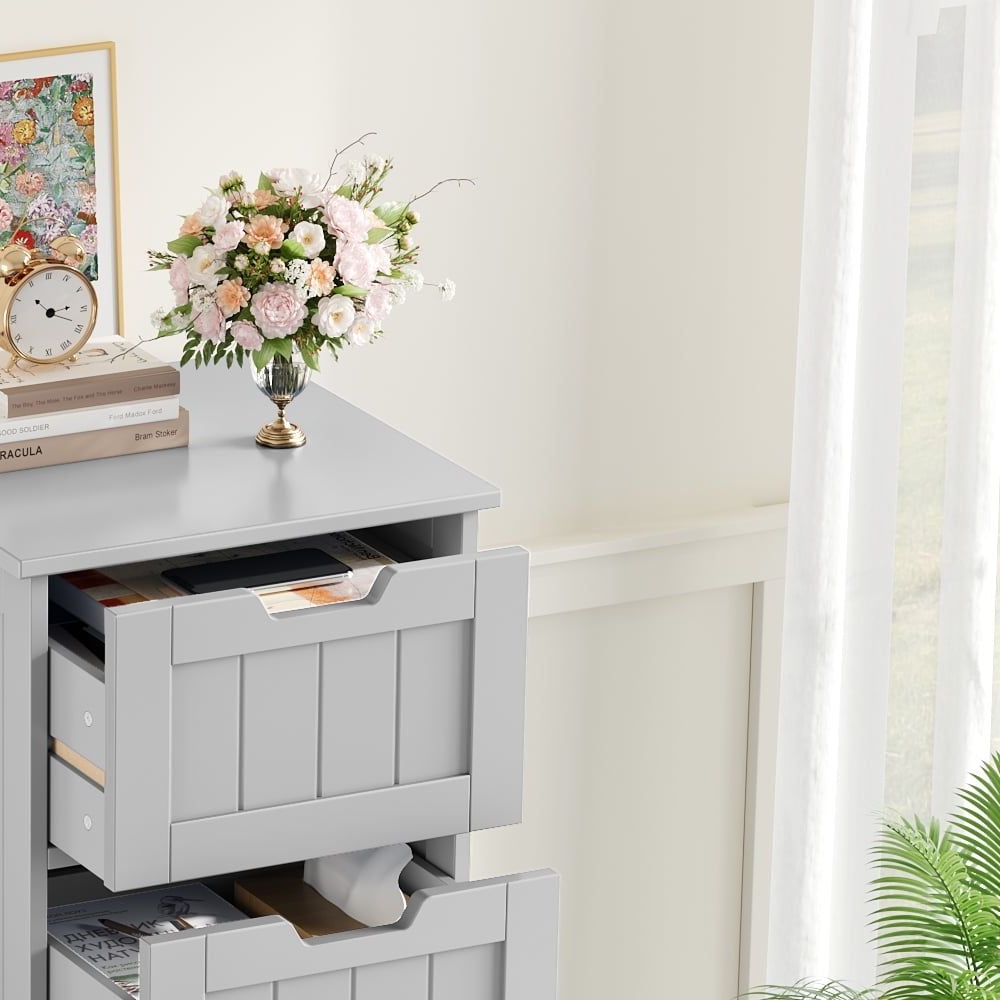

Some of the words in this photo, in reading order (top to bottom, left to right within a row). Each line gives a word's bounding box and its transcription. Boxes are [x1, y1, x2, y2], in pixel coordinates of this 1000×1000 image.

[19, 423, 50, 434] SOLDIER
[135, 432, 153, 441] Bram
[155, 428, 178, 438] Stoker
